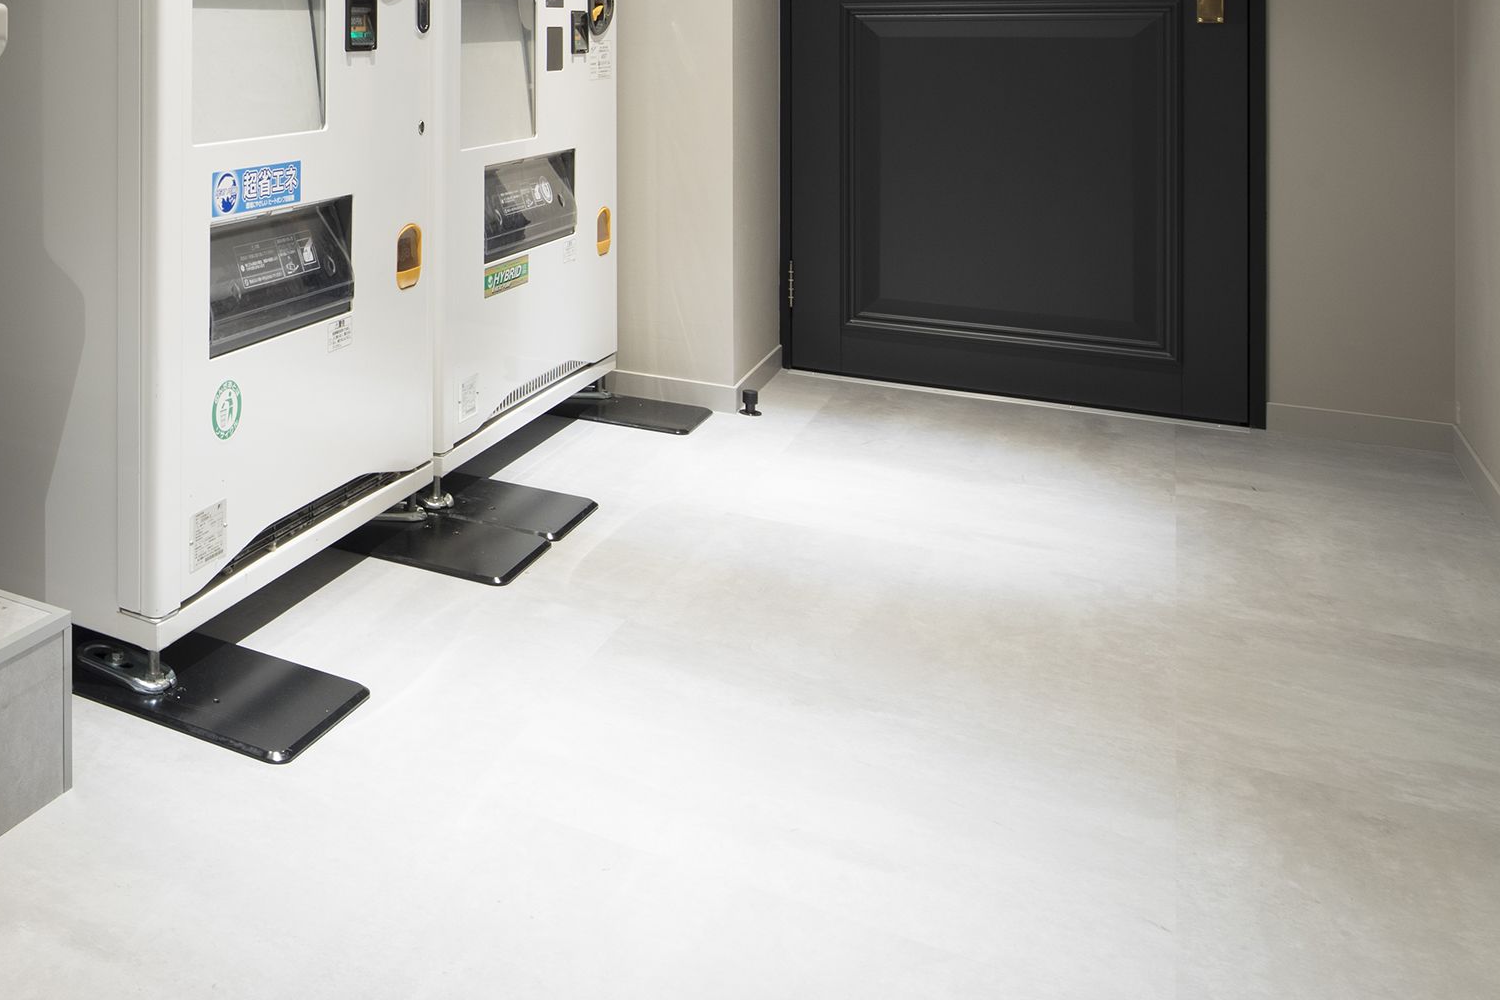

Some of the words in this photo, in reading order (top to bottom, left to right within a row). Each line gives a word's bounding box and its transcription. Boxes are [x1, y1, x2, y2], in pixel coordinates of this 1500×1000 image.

[243, 165, 298, 202] 超省エネ
[493, 264, 522, 286] HYBRID
